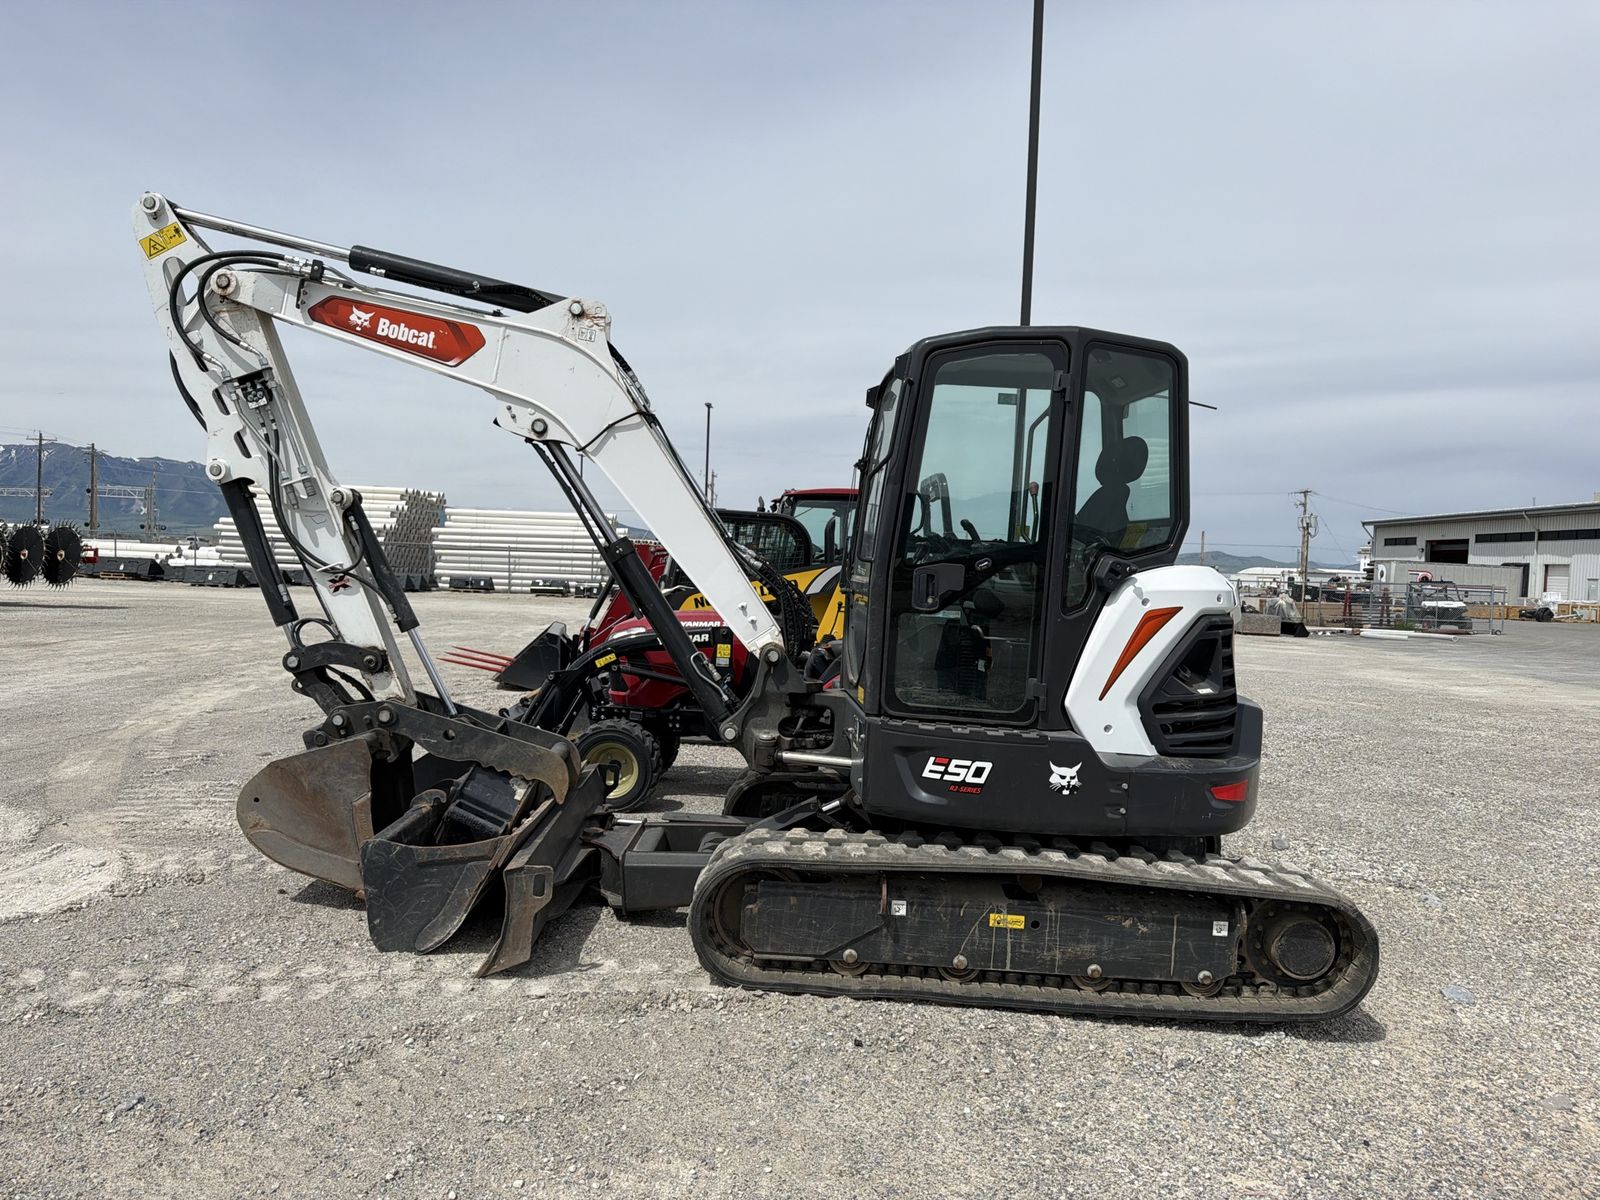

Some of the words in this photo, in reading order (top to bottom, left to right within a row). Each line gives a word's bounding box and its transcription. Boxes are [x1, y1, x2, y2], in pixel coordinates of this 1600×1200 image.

[377, 317, 435, 349] Bobcat
[921, 756, 993, 784] E50
[949, 785, 982, 794] R2-SERIES
